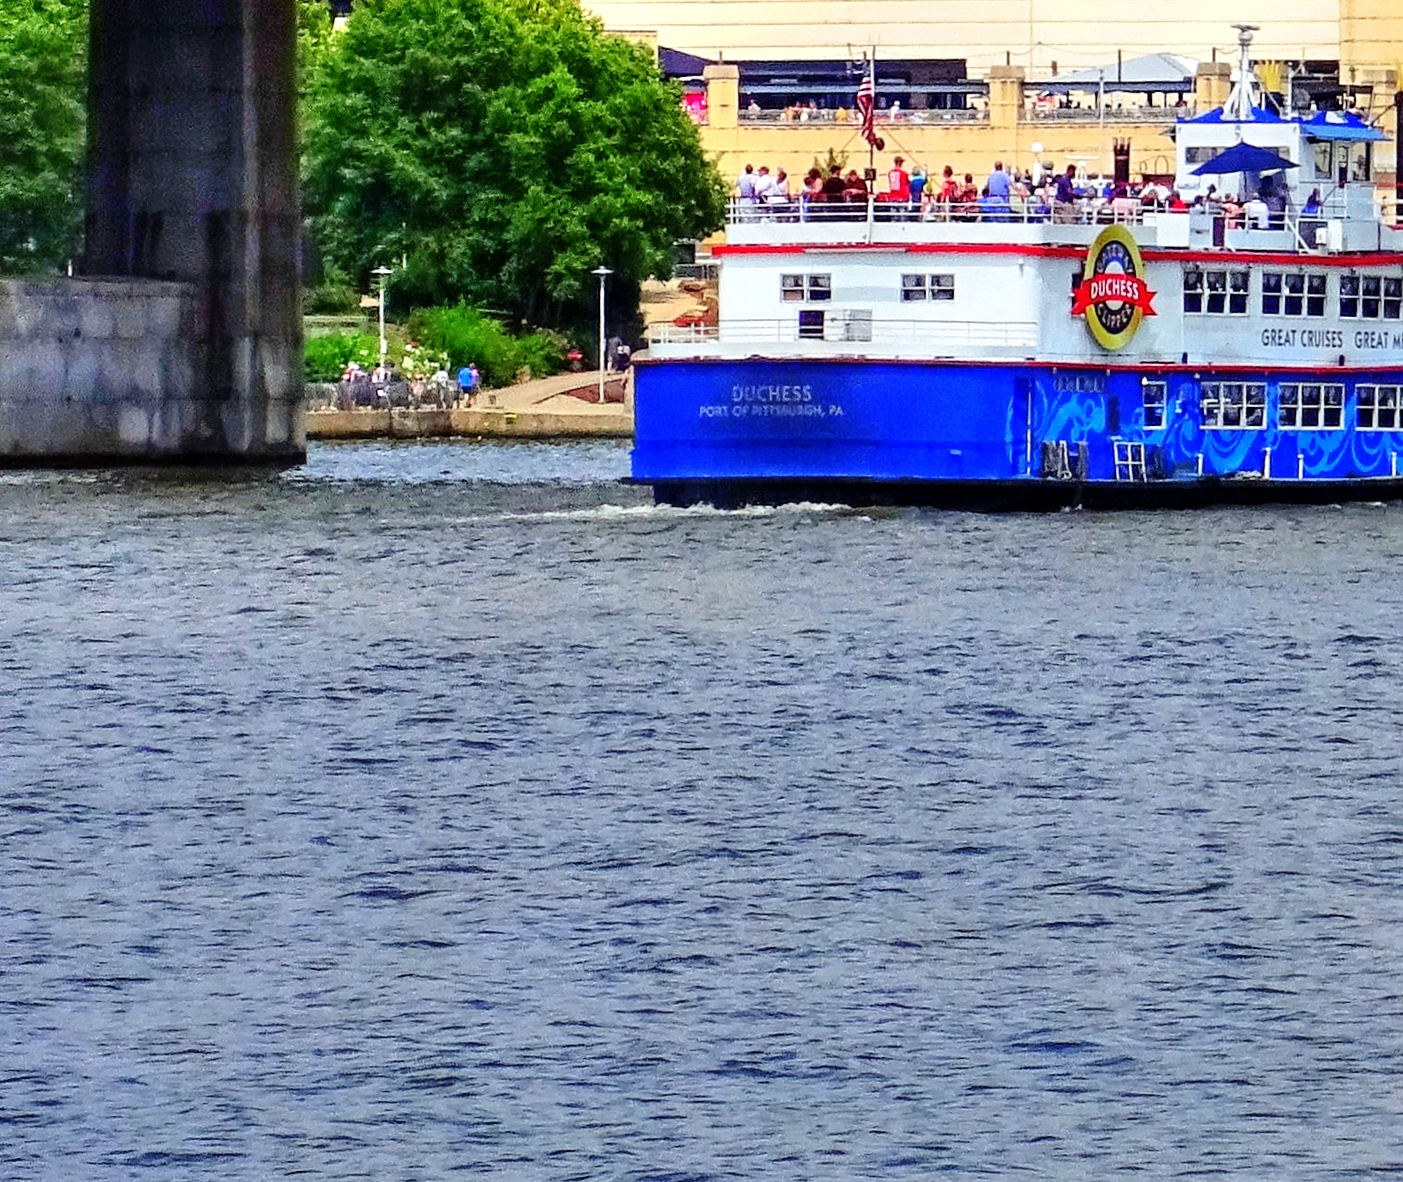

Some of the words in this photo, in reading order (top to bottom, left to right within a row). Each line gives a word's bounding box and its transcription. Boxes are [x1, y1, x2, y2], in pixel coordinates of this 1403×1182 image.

[1090, 278, 1139, 300] DUCHESS
[1261, 328, 1297, 348] GREAT
[1300, 329, 1344, 349] CRUISES
[1354, 331, 1389, 350] GREAT
[732, 384, 813, 402] DUCHESS
[699, 405, 729, 418] PORT
[732, 405, 750, 418] OF
[828, 405, 844, 417] PA
